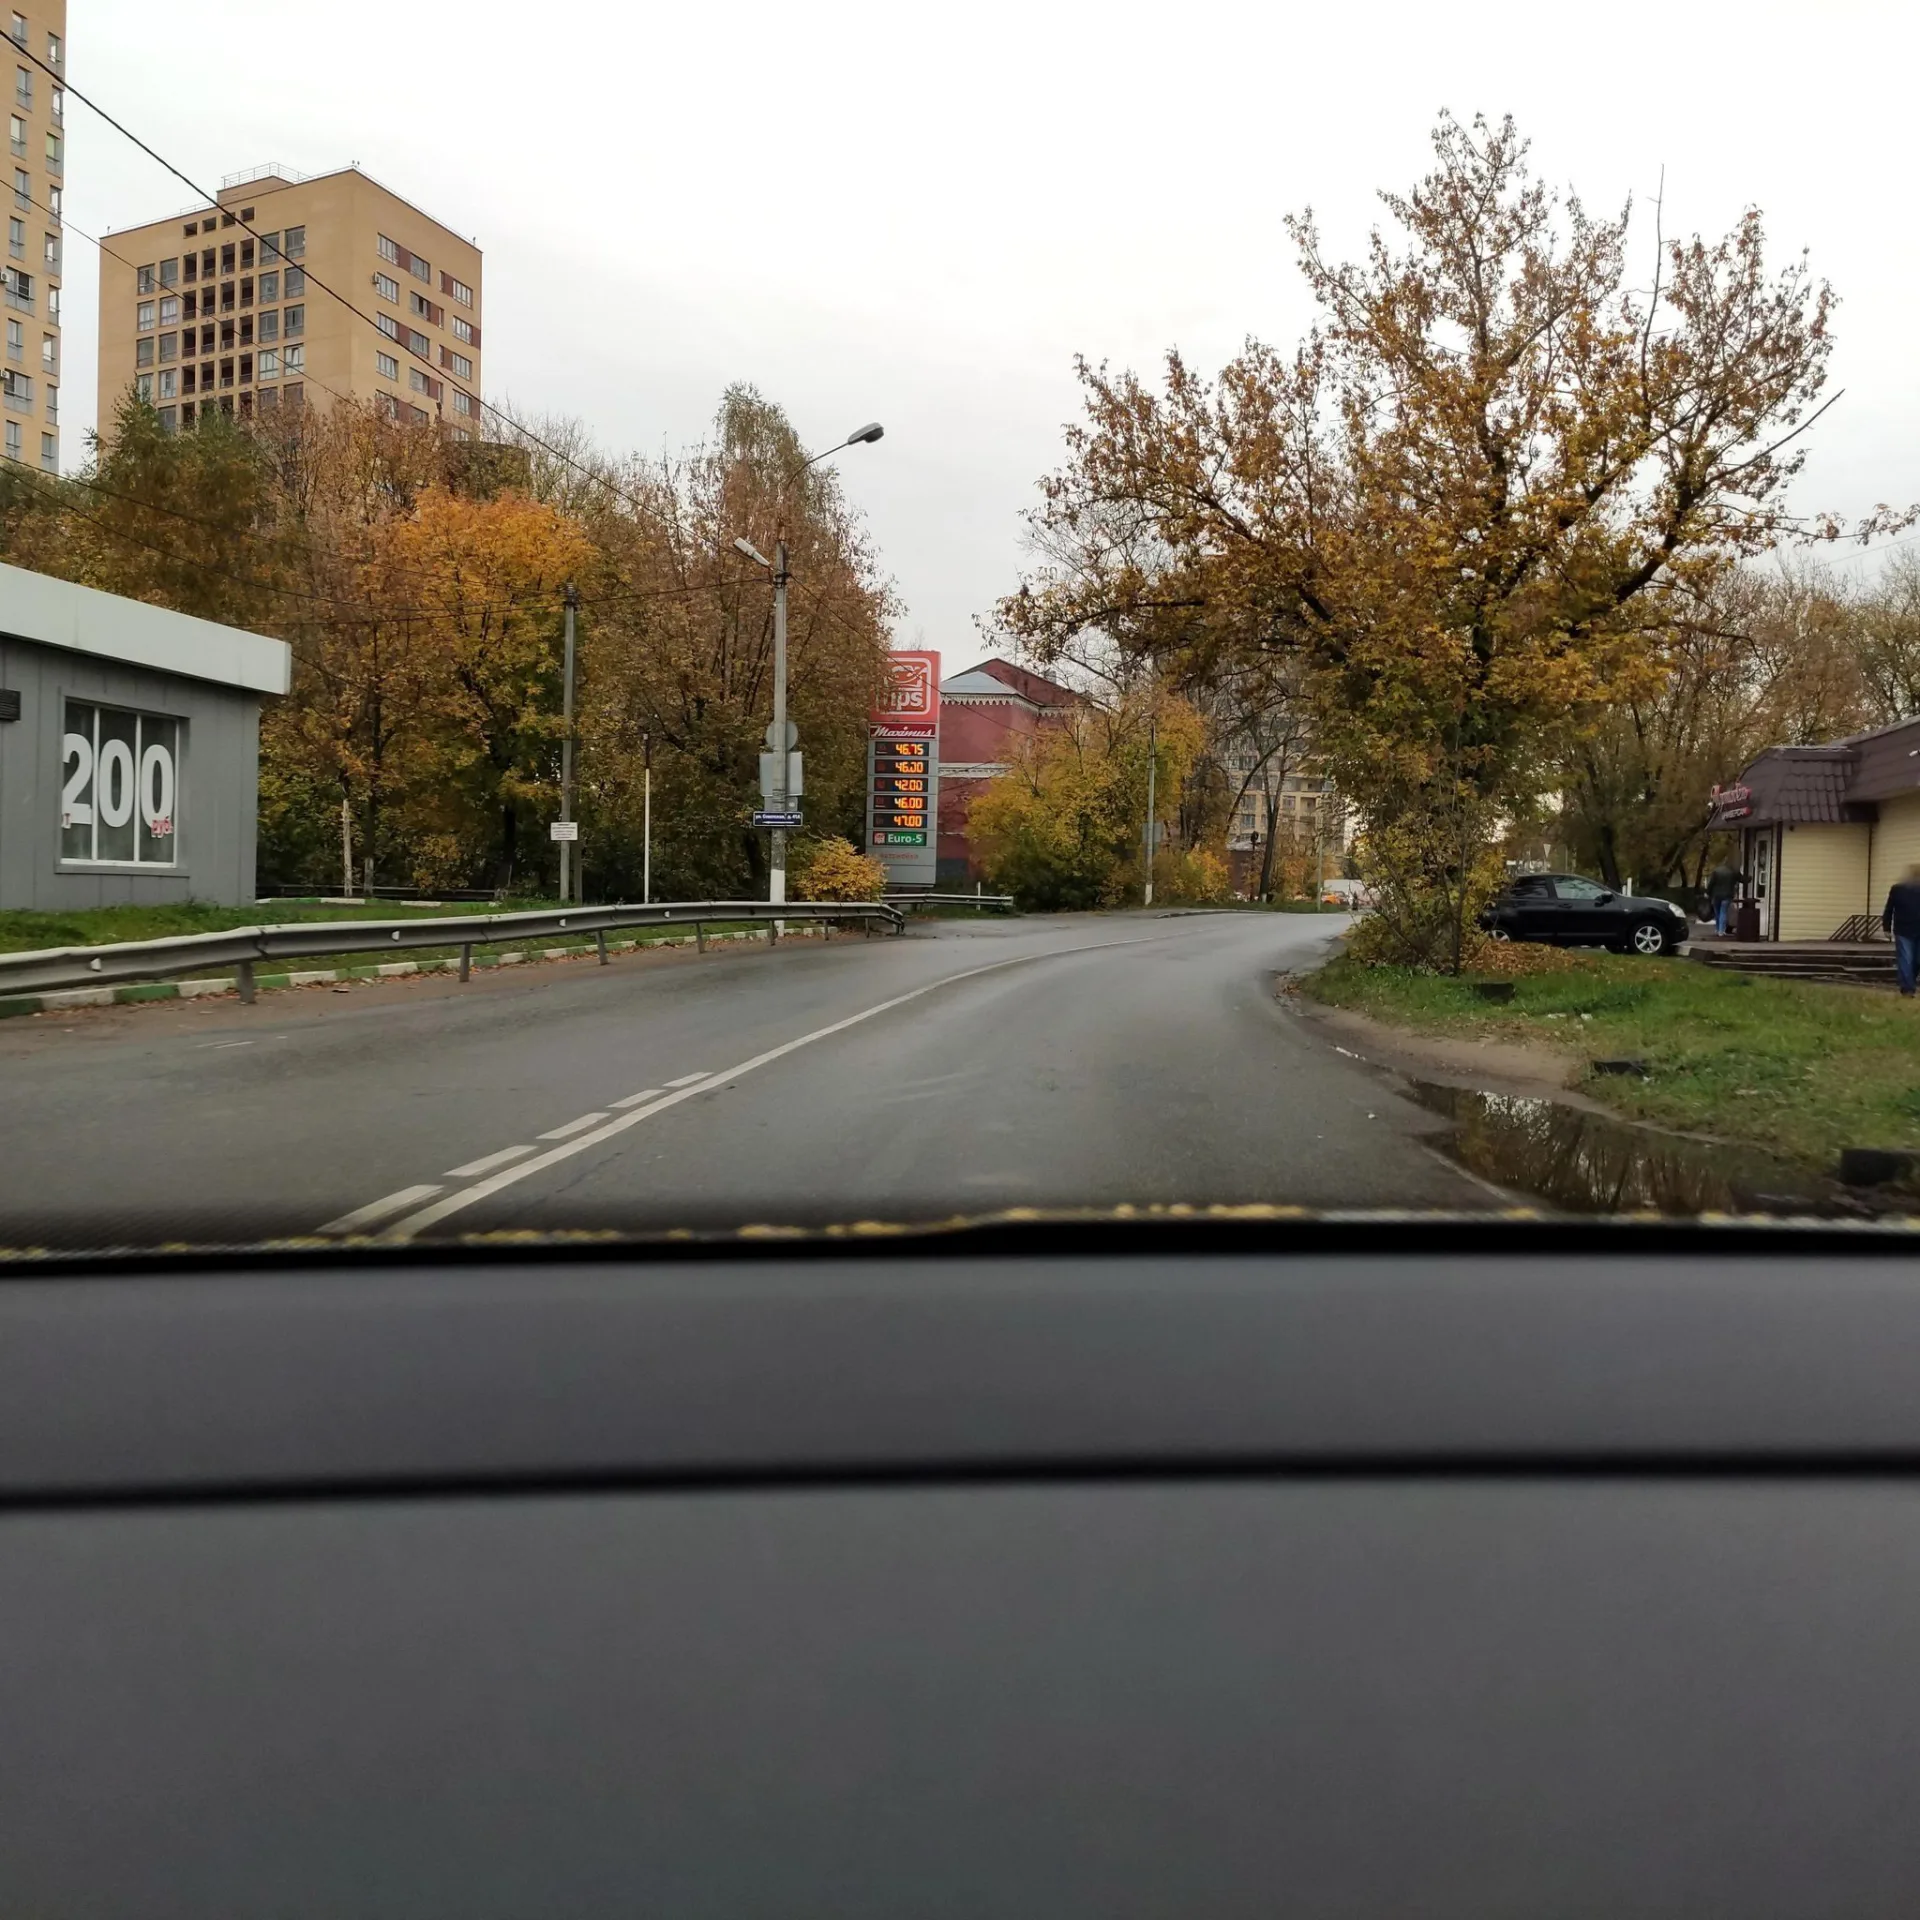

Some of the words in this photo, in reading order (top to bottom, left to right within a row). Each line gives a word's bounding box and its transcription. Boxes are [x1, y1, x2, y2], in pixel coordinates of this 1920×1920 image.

[870, 724, 936, 738] Maximus
[895, 743, 924, 756] 46.75
[62, 733, 174, 828] 200
[894, 779, 923, 791] 42.00
[894, 797, 923, 809] 46.00
[893, 815, 922, 827] 47.00
